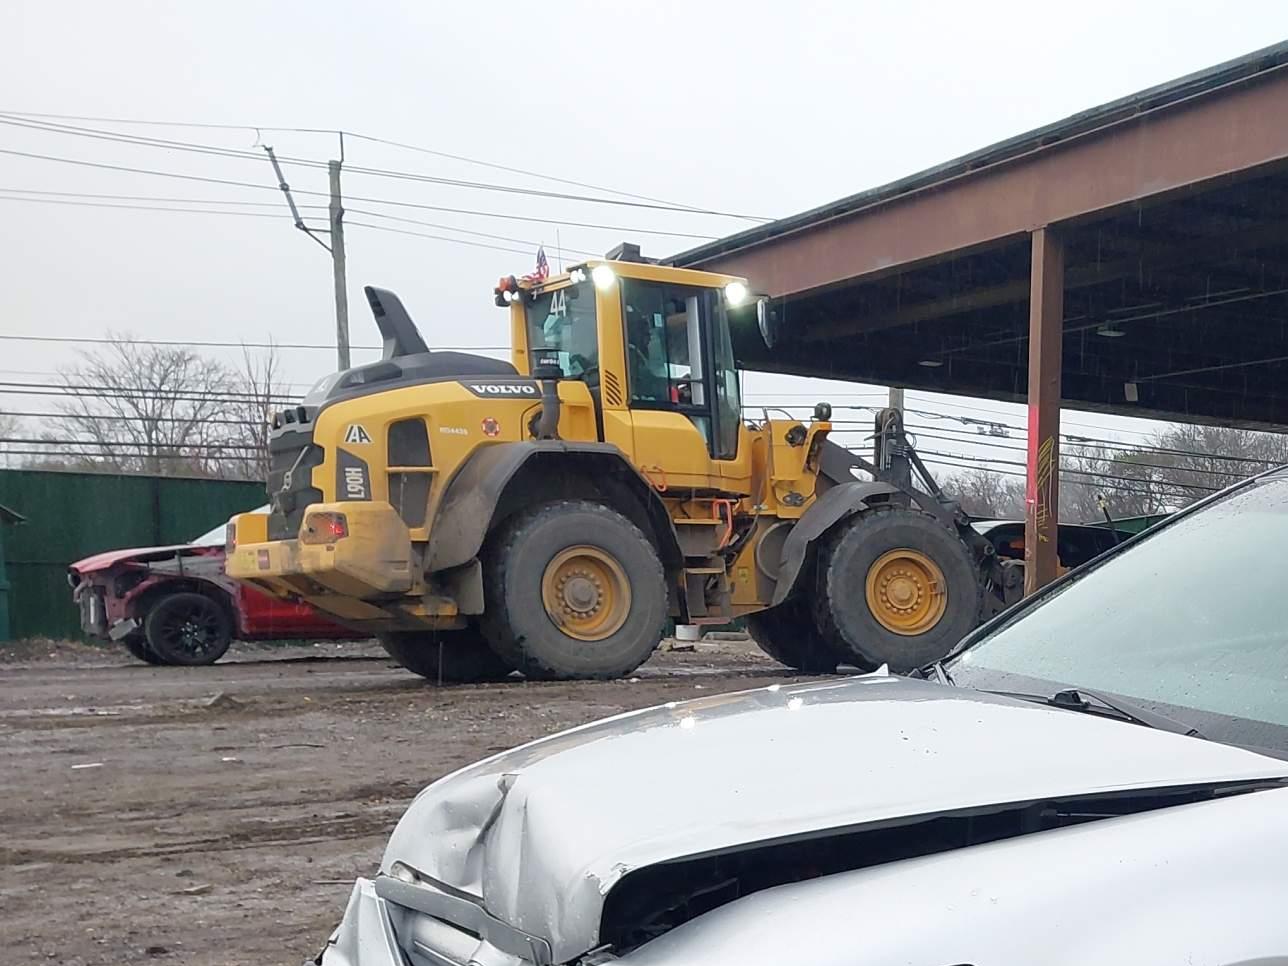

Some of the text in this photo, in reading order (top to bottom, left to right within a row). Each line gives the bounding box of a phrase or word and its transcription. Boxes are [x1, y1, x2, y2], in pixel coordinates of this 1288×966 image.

[550, 289, 567, 318] 44
[470, 384, 536, 394] VOLVO
[344, 467, 366, 498] L90H
